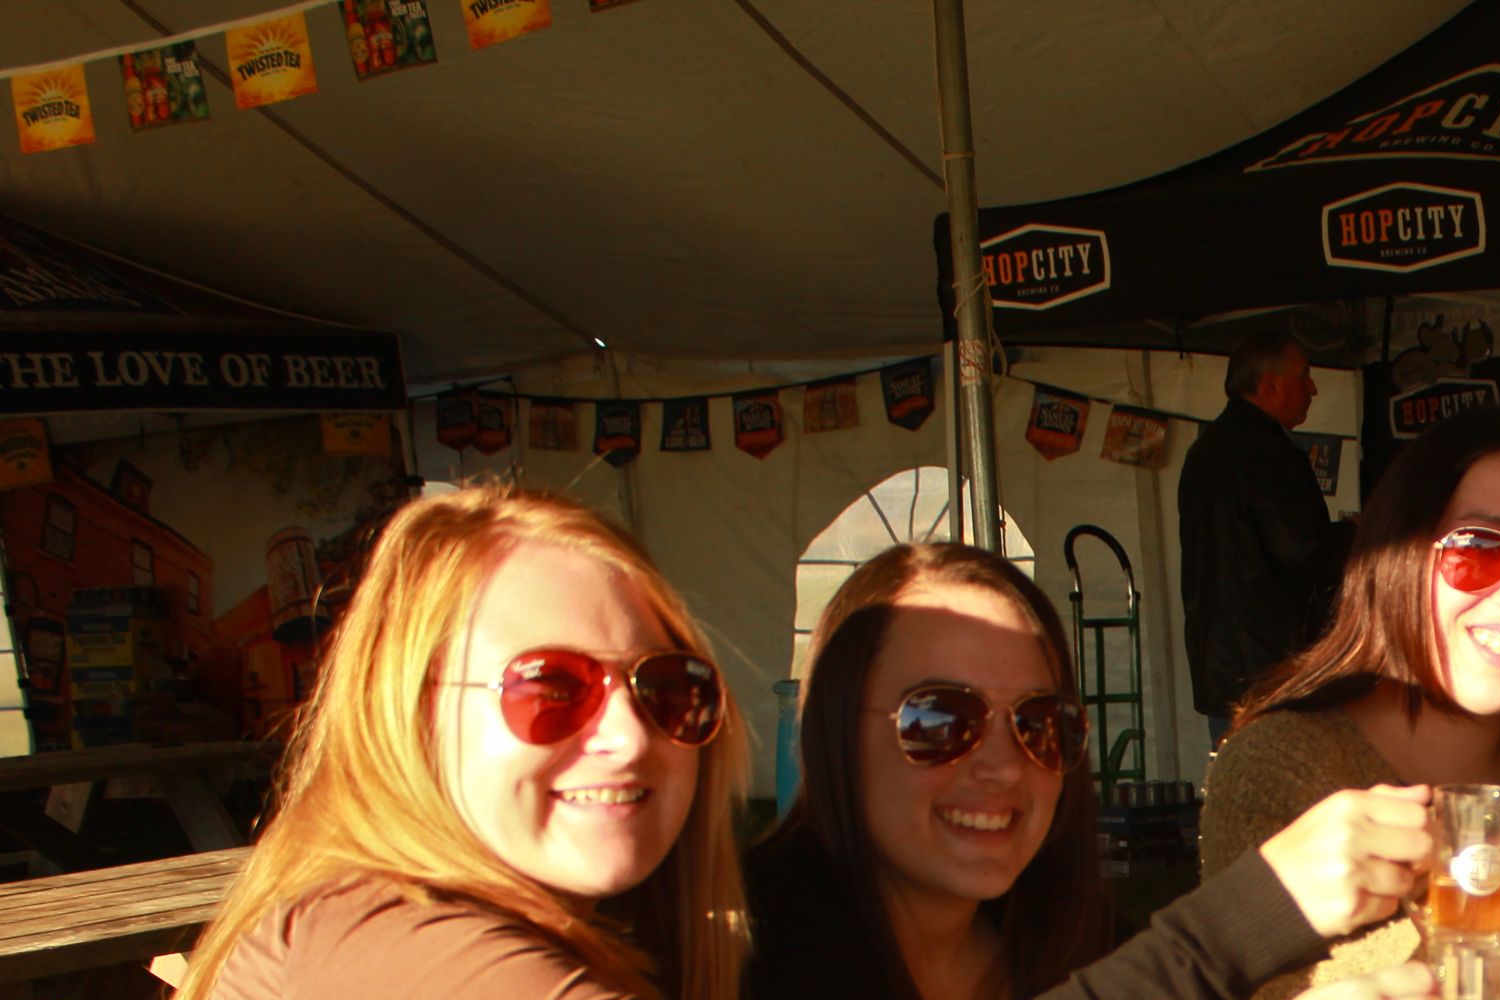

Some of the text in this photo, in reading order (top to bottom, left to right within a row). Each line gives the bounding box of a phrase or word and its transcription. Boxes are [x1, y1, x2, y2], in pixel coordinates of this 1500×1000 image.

[237, 49, 300, 81] TWISTED TEA
[22, 99, 81, 127] TWISTED TEA
[1338, 204, 1465, 247] HOPCITY
[88, 350, 209, 388] LOVE
[219, 353, 272, 389] OF
[282, 354, 386, 390] BEER
